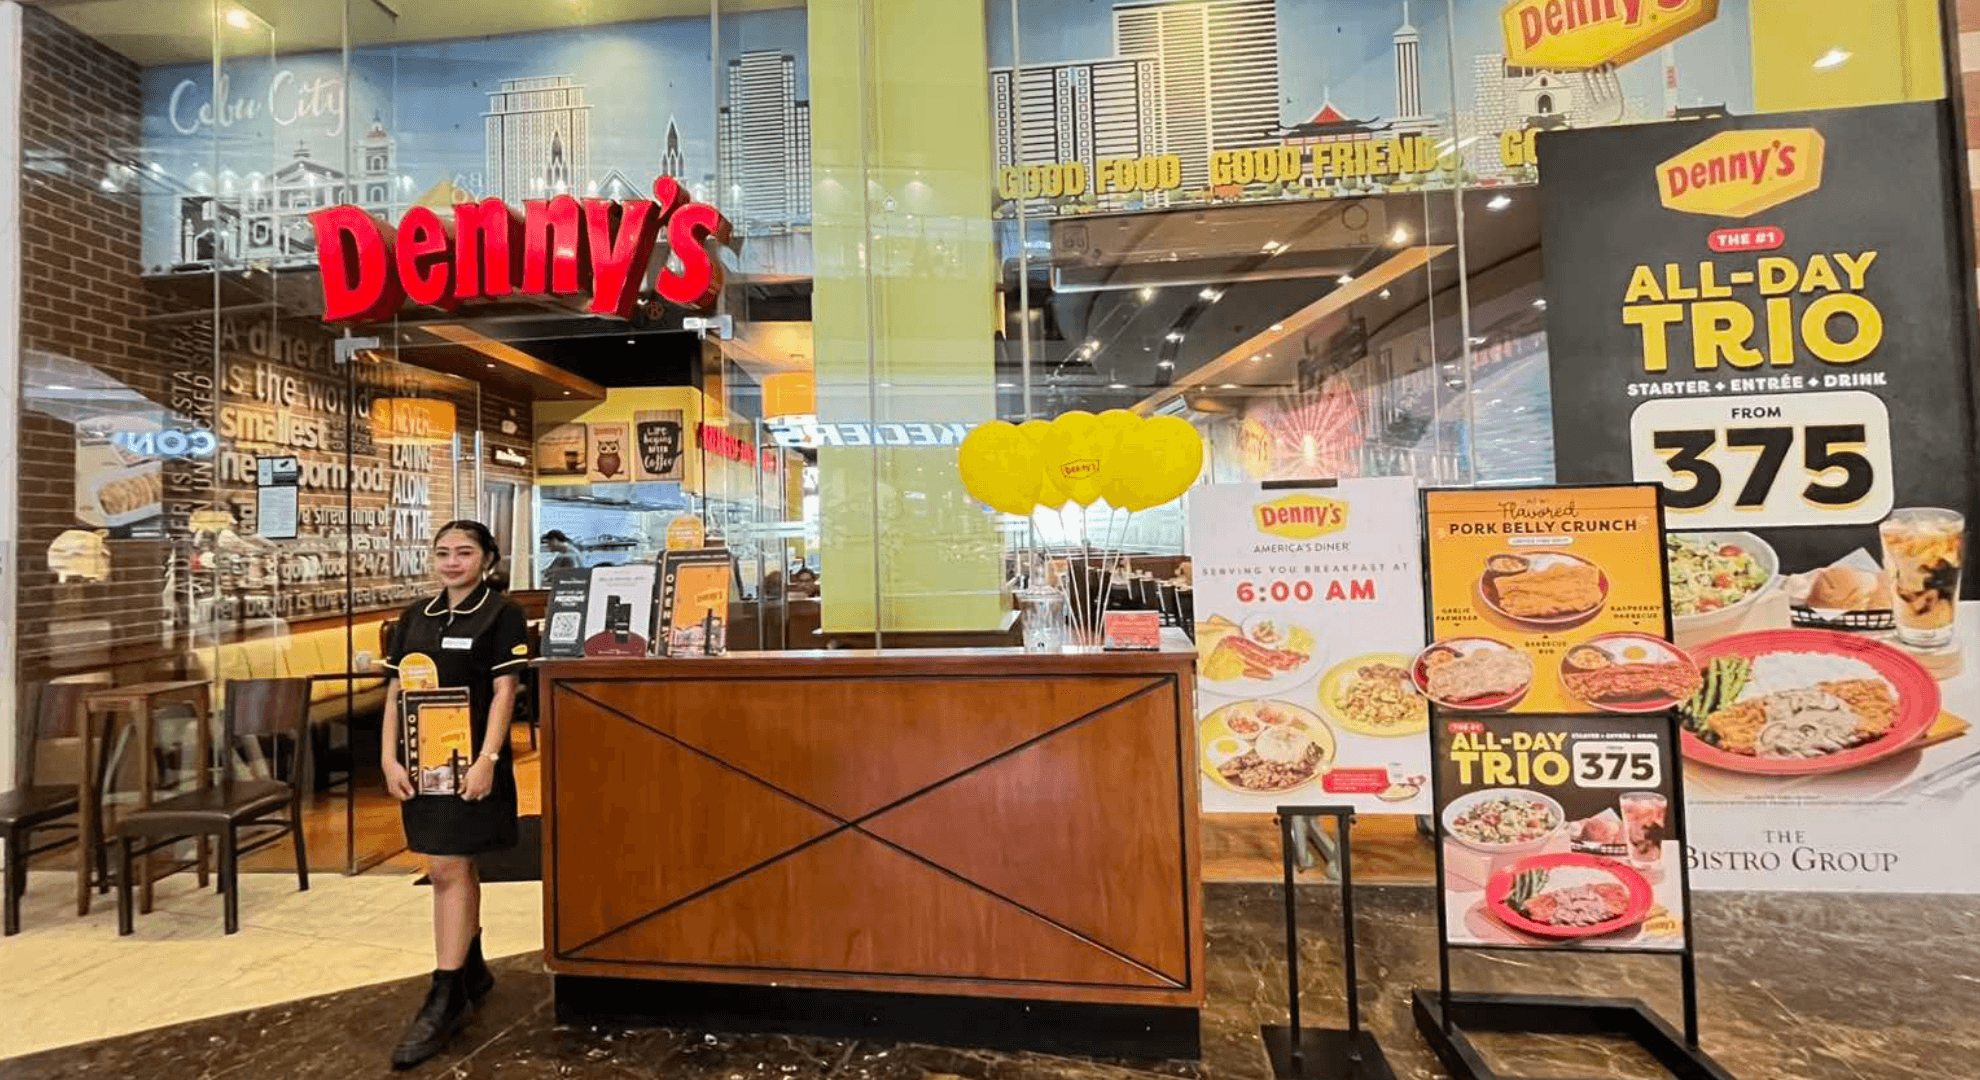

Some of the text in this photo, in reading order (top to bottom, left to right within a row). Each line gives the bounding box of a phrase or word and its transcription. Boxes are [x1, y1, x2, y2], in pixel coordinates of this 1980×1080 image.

[268, 70, 344, 136] City
[999, 161, 1086, 199] GOOD
[1096, 154, 1181, 194] FOOD
[1210, 148, 1301, 186] GOOD
[1666, 139, 1797, 198] Denny's
[307, 174, 728, 323] Denny's
[1716, 232, 1776, 246] THE #1
[1624, 251, 1878, 303] ALL-DAY
[1622, 292, 1884, 371] TRIO
[1627, 381, 1711, 396] STARTER
[1730, 374, 1804, 392] ENTRÉE
[1824, 372, 1888, 388] DRINK
[1731, 407, 1781, 420] FROM
[220, 405, 329, 450] smallest
[1653, 424, 1874, 509] 375
[1260, 503, 1342, 527] Denny's
[1498, 501, 1580, 520] Flavored
[1450, 519, 1638, 535] PORK BELLY CRUNCH
[1253, 542, 1349, 553] AMERICA'S DINER
[1202, 562, 1409, 576] SERVING YOU BREAKFAST AT
[1236, 578, 1376, 603] 6:00 AM
[1451, 731, 1568, 750] ALL-DAY
[1450, 751, 1571, 785] TRIO
[1580, 752, 1654, 781] 375
[1764, 829, 1807, 844] THE
